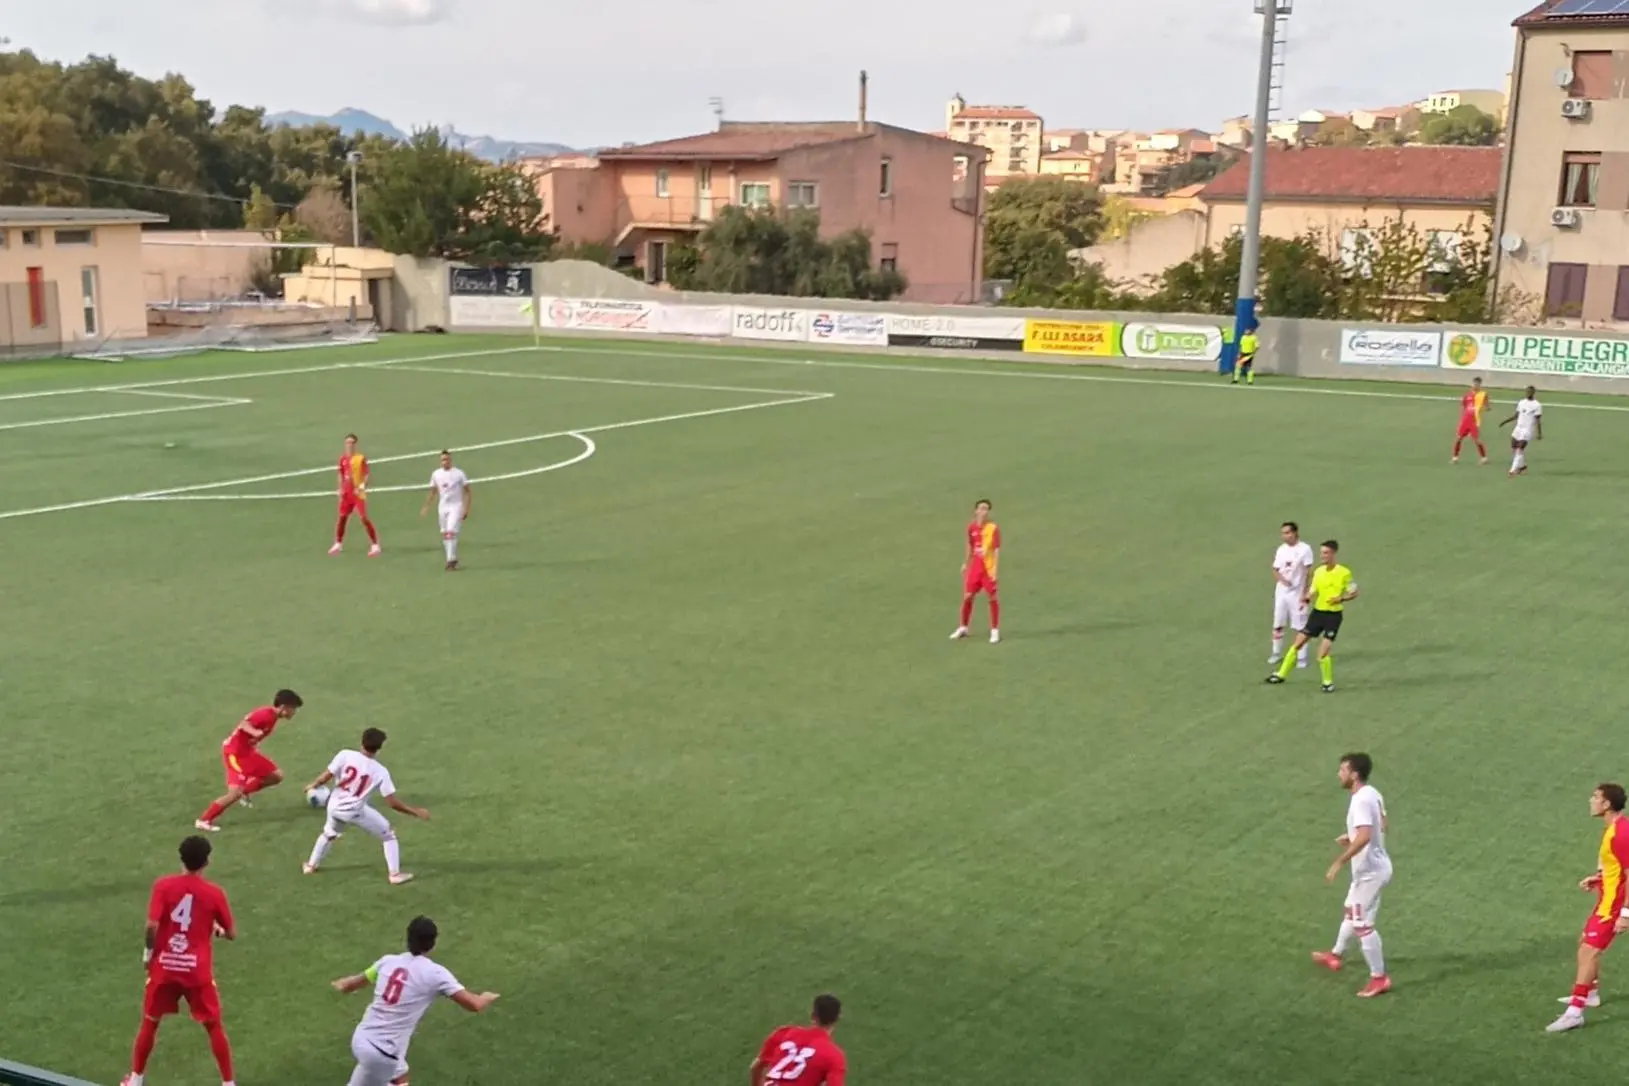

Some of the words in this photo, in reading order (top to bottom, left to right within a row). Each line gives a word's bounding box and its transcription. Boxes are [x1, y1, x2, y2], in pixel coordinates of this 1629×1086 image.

[735, 311, 797, 332] radoff
[1493, 336, 1516, 357] DI
[1523, 338, 1628, 363] PELLEGR
[338, 765, 371, 797] 21
[170, 893, 194, 932] 4
[383, 967, 409, 1006] 6
